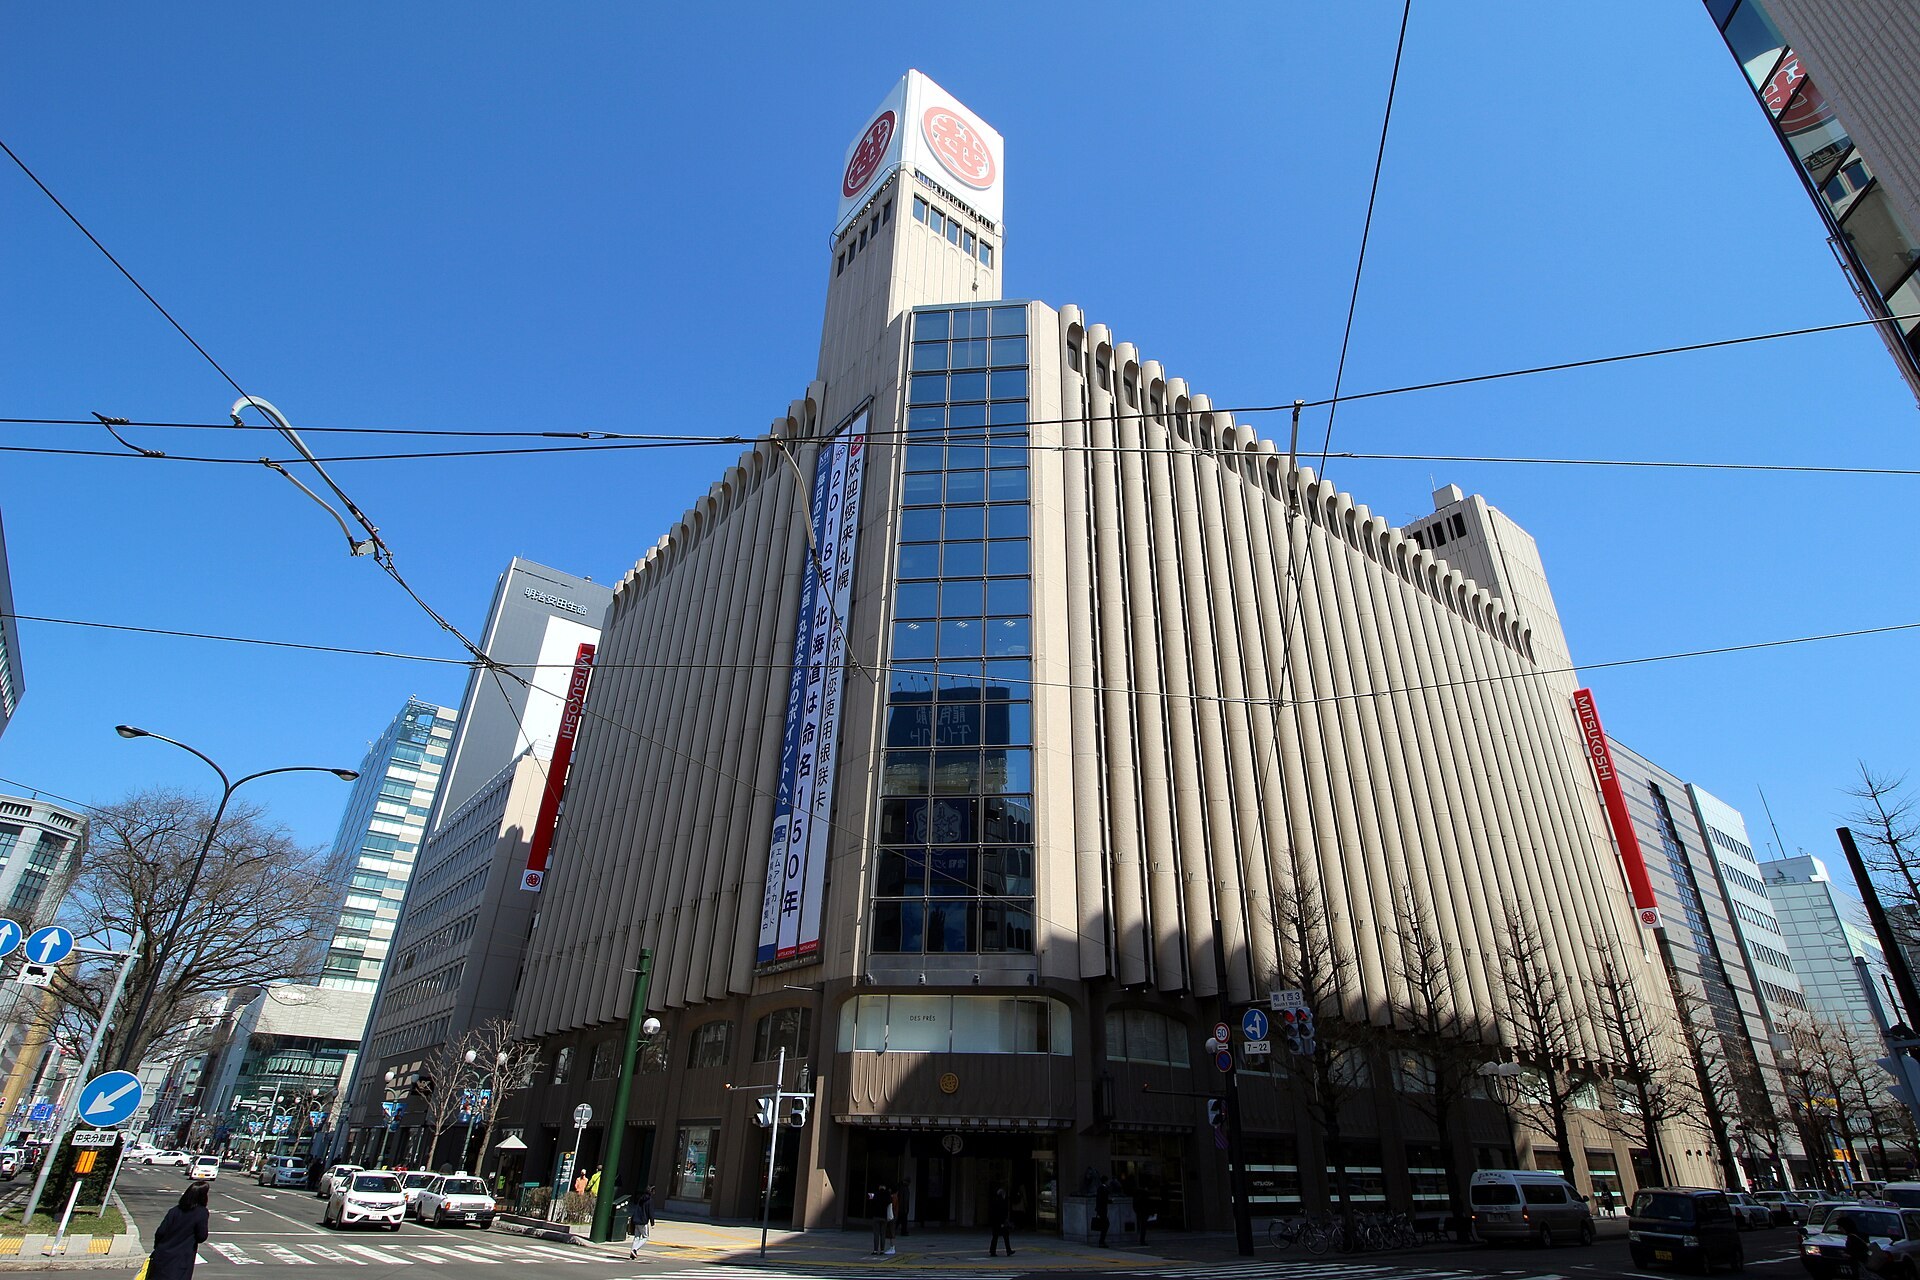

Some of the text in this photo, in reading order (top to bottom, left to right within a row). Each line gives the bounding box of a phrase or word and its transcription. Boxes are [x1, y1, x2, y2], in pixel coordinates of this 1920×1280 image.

[837, 457, 860, 593] 欢迎您来札幌
[523, 586, 588, 616] 明治安田生命
[561, 652, 592, 739] MITSUKOSHI
[1577, 696, 1612, 781] MITSUKOSHI
[1272, 992, 1301, 1002] 南1西3
[1217, 1028, 1226, 1038] 50
[75, 1134, 115, 1143] 中央分離帯
